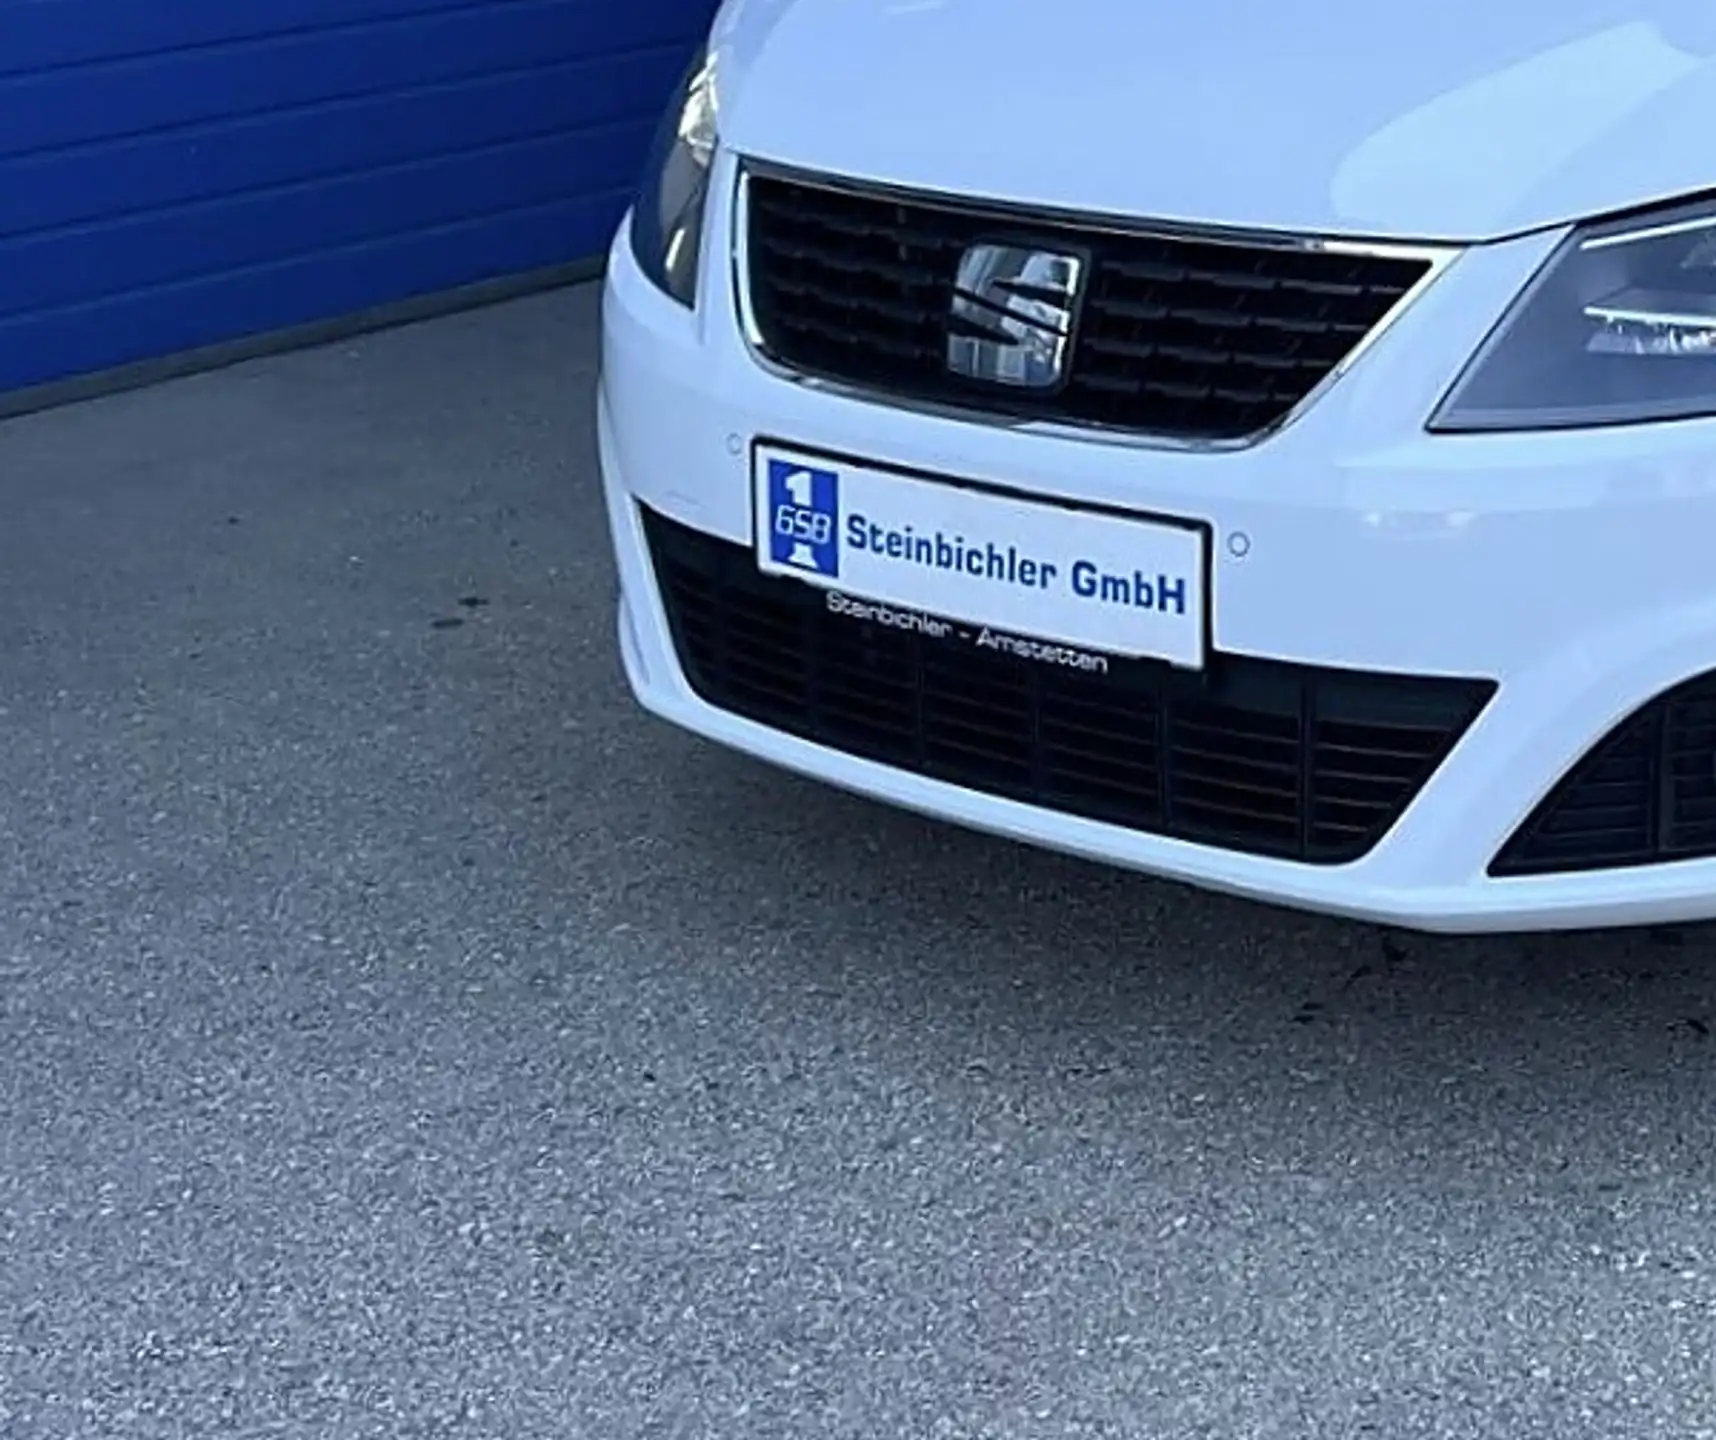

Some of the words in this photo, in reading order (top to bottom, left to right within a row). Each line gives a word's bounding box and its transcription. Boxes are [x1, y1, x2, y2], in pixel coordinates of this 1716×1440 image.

[846, 513, 1057, 589] Steinbichler
[1071, 560, 1186, 615] GmbH
[825, 590, 952, 637] Steinbichler
